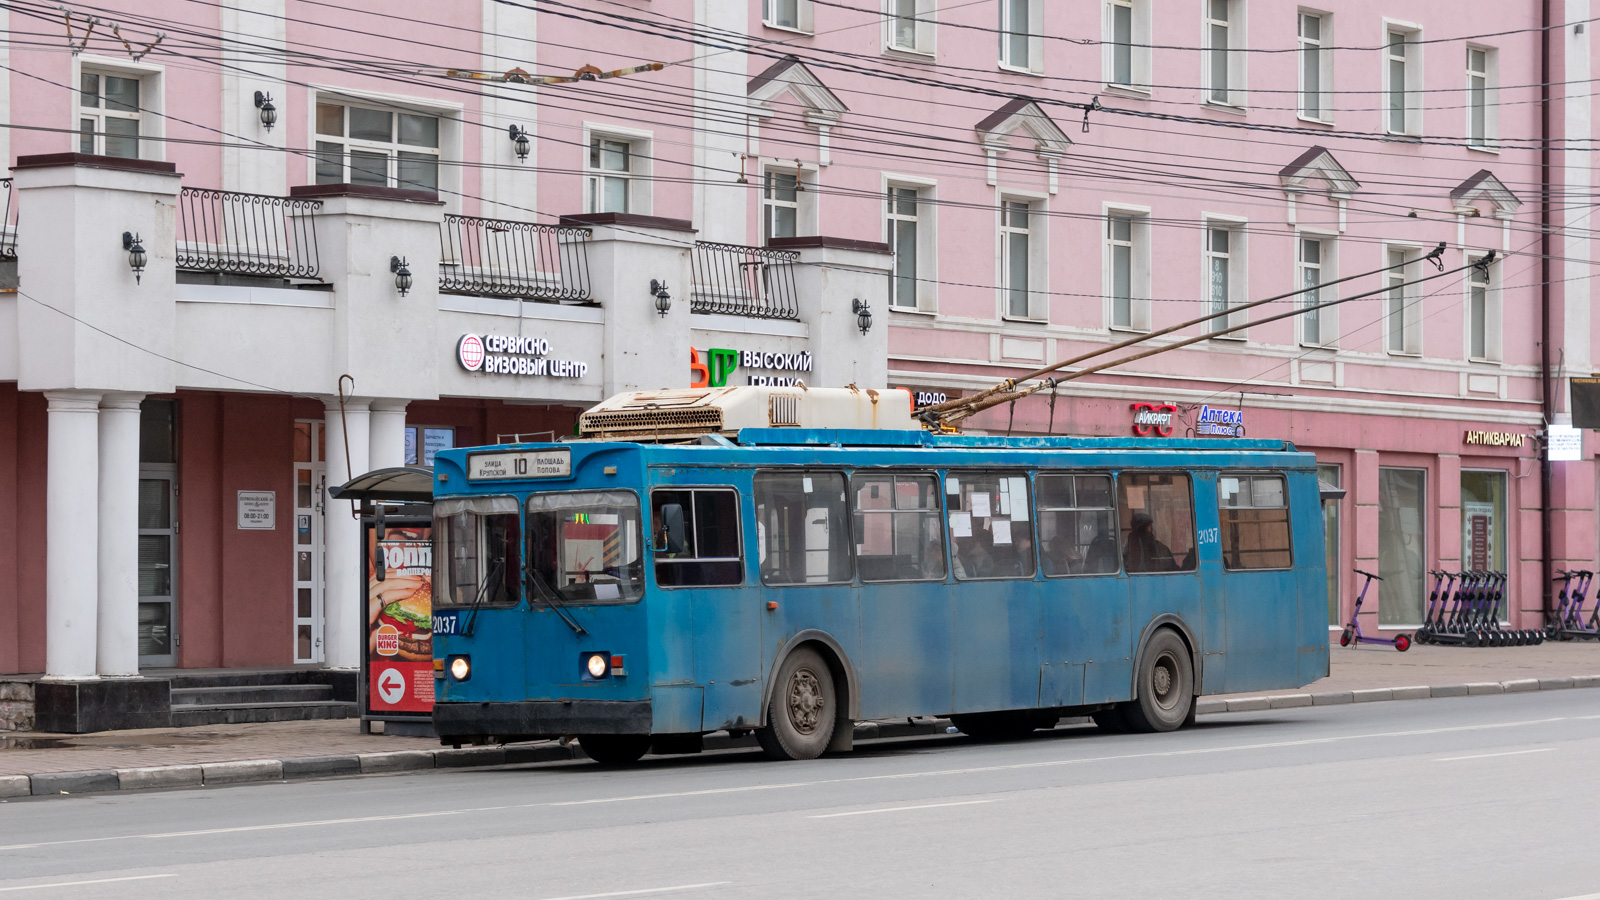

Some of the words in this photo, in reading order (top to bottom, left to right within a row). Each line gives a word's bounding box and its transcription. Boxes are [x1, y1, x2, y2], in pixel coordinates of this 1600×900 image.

[1214, 260, 1220, 271] 8
[1307, 269, 1312, 280] 8
[485, 334, 553, 356] СЕРВИСНО-
[485, 355, 547, 376] ВИЗОВЫЙ
[550, 359, 588, 378] ЦЕНТР
[743, 350, 812, 372] ВЫСОКИЙ
[918, 392, 946, 405] ДОДО
[1138, 410, 1172, 425] АЙКРАФТ
[1466, 430, 1526, 448] АНТИКВАРИАТ
[484, 460, 502, 468] УЛИЦА
[513, 458, 528, 475] 10
[536, 458, 565, 466] ПЛОЩАДЬ
[1198, 527, 1218, 545] 2037
[432, 615, 457, 634] 2037
[377, 641, 398, 650] KING
